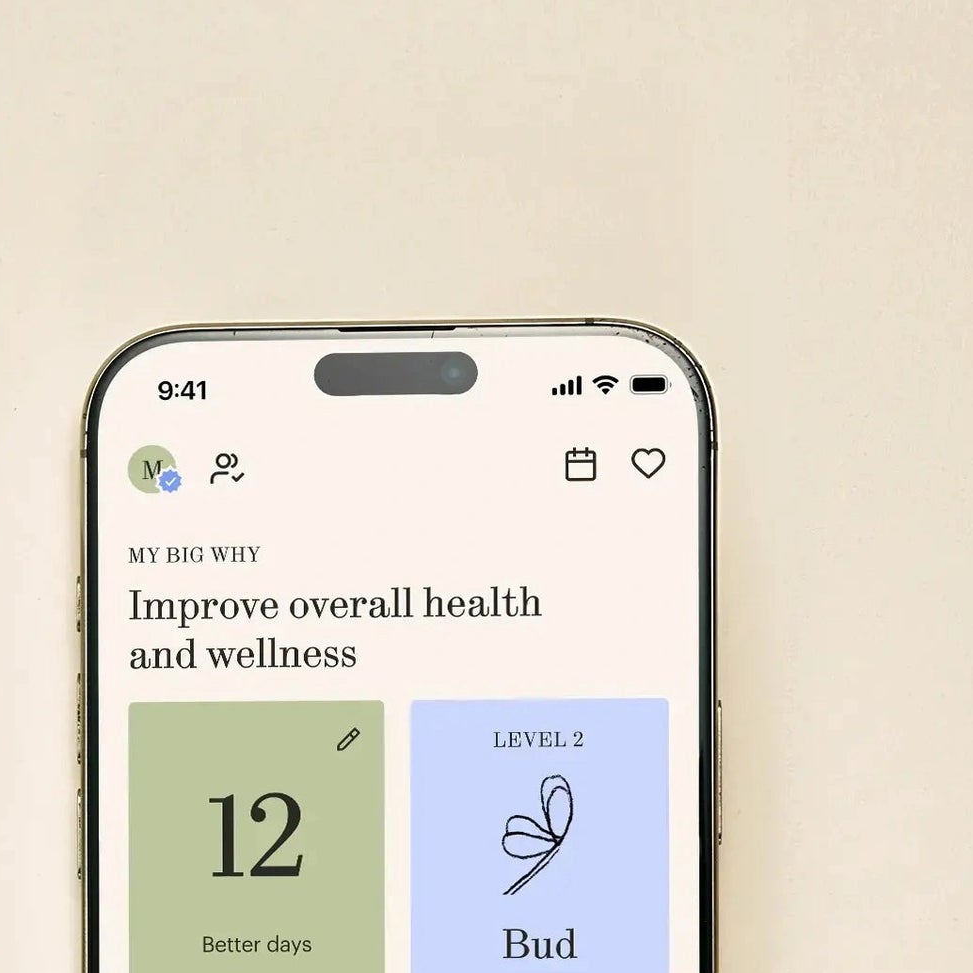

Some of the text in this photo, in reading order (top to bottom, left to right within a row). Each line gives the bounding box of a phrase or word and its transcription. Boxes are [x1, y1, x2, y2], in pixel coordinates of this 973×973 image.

[157, 380, 207, 401] 9:41
[142, 459, 164, 480] M
[128, 545, 261, 564] MY BIG WHY
[128, 585, 543, 629] Improve overall health
[129, 636, 357, 670] and wellness
[493, 730, 584, 748] LEVEL 2
[208, 791, 304, 878] 12
[202, 934, 312, 956] Better days
[502, 927, 579, 960] Bud
